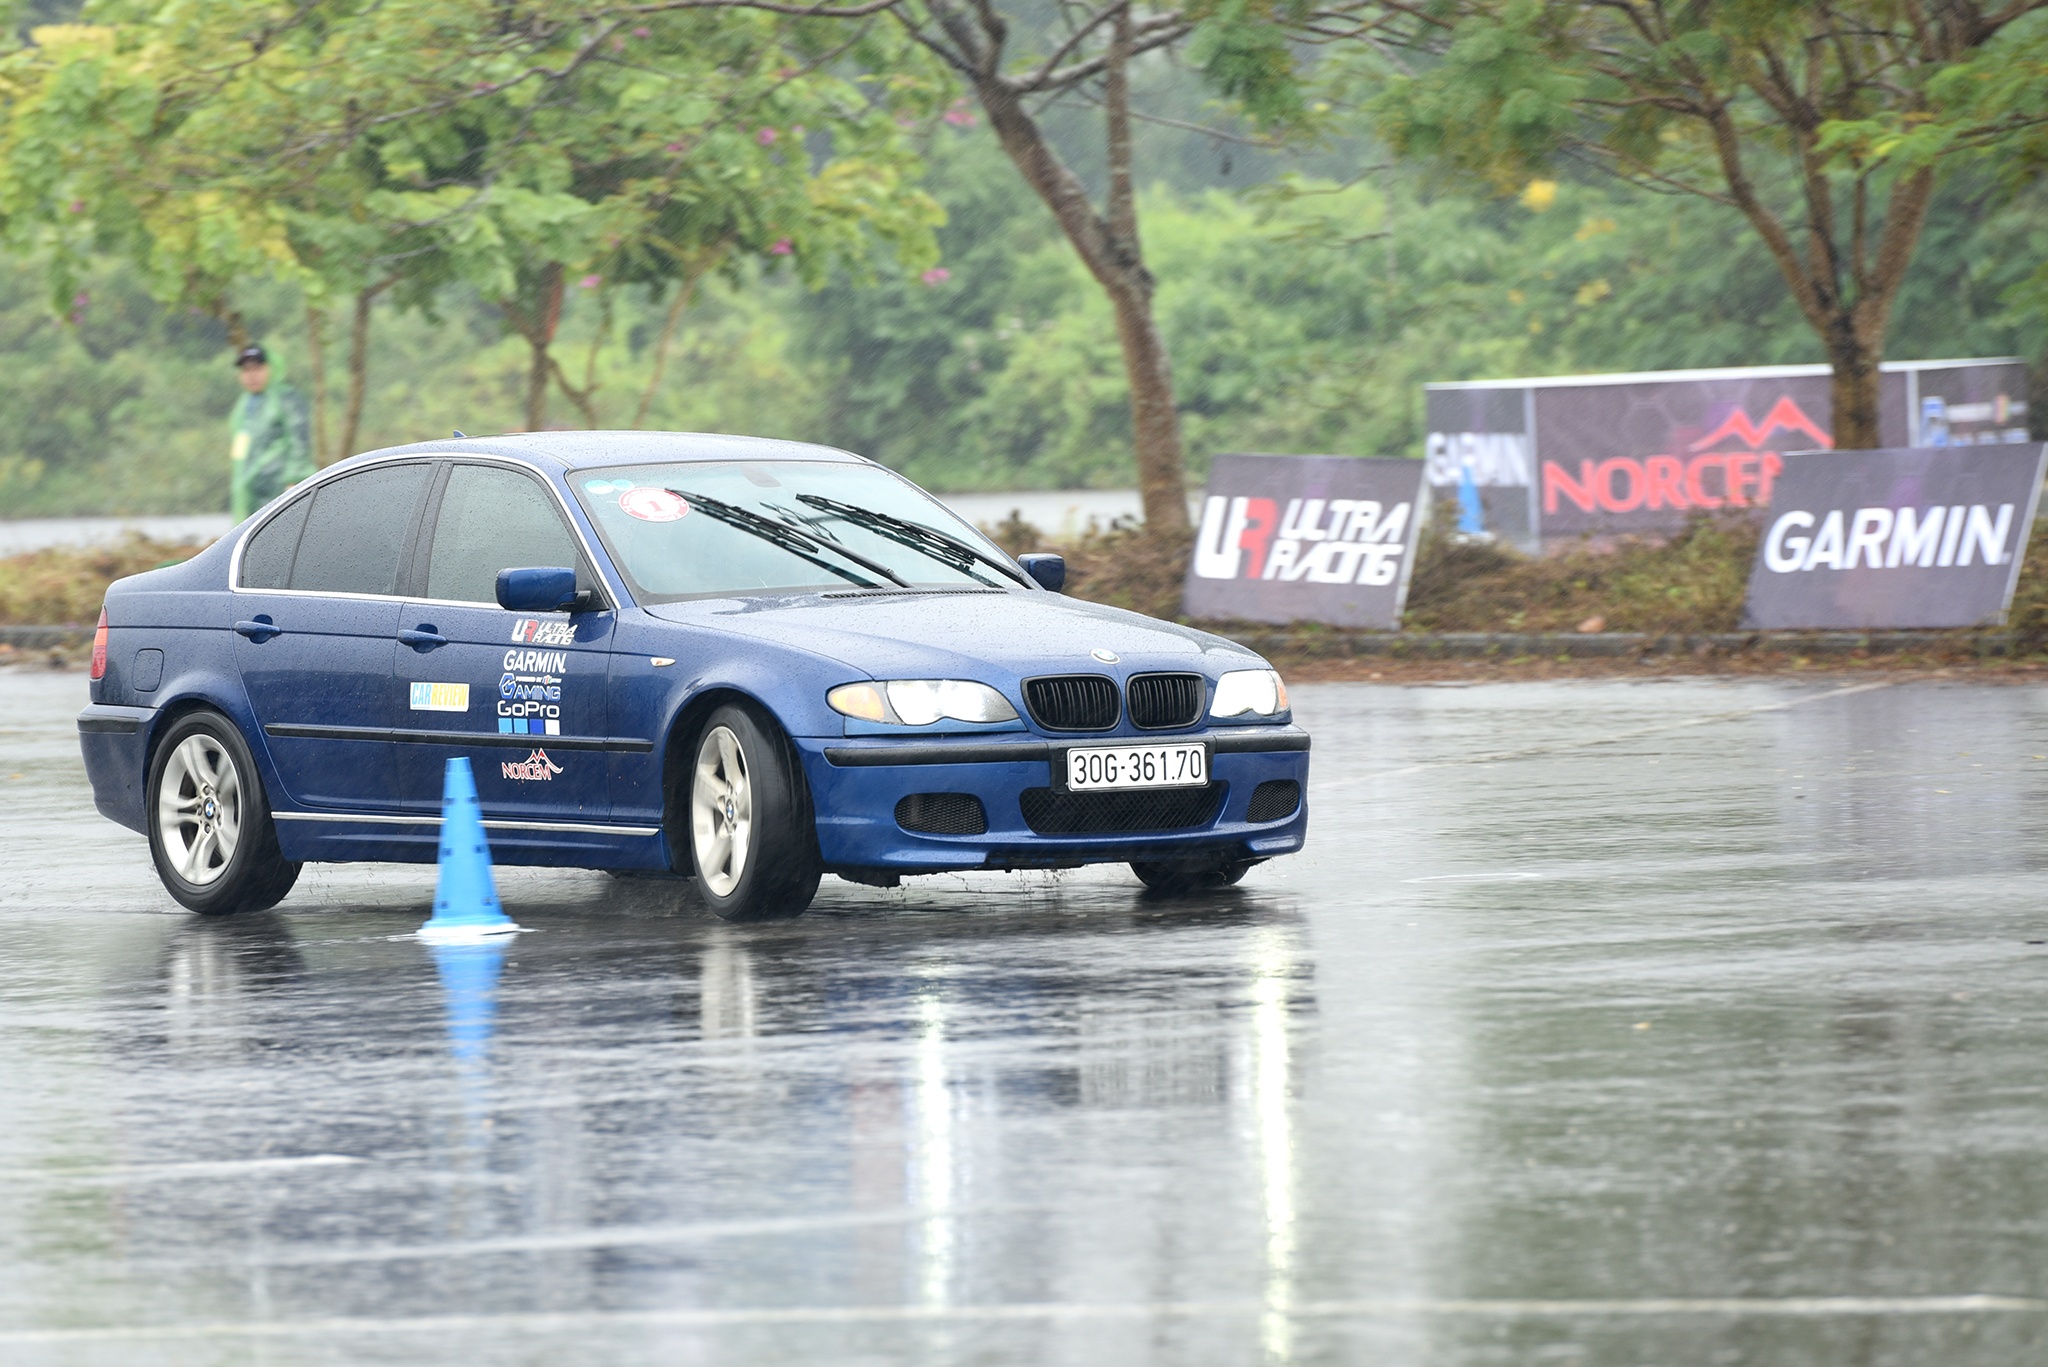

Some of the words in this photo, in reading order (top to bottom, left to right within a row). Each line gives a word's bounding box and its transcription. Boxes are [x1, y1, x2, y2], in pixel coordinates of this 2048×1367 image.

[1279, 498, 1411, 543] ULTRA
[1764, 503, 2014, 573] GARMIN
[538, 621, 578, 636] ULTRA
[503, 649, 567, 674] GARMIN
[499, 672, 561, 702] GAMING
[498, 701, 560, 718] GoPro
[501, 762, 552, 780] NORCEM
[1073, 750, 1202, 784] 30G-361.70
